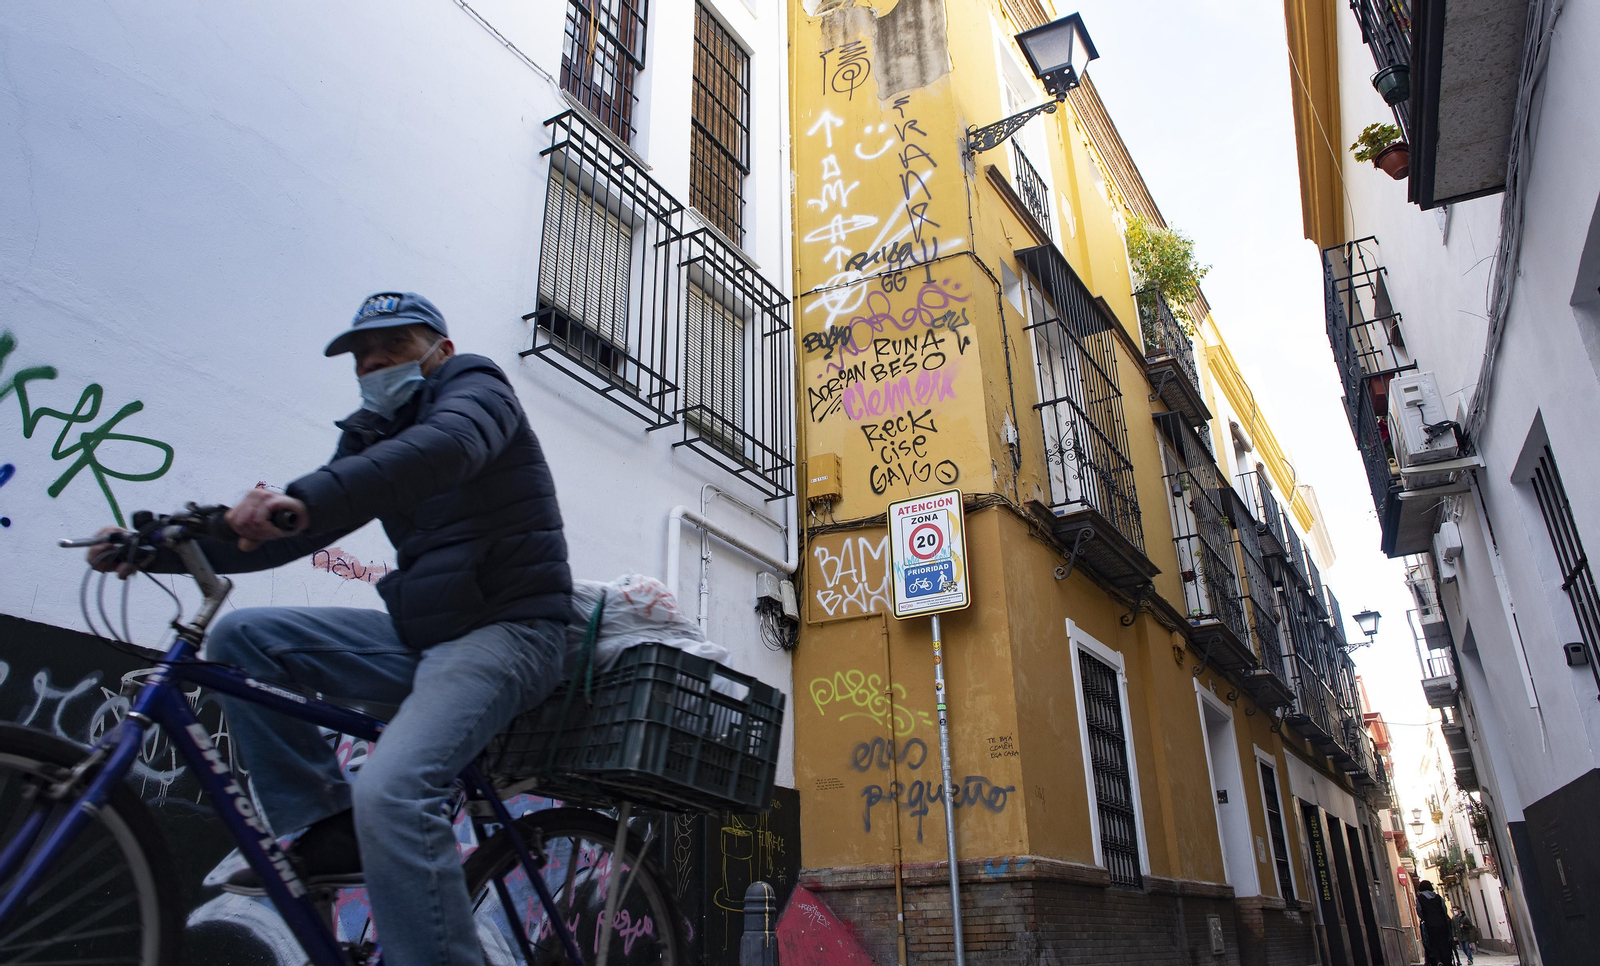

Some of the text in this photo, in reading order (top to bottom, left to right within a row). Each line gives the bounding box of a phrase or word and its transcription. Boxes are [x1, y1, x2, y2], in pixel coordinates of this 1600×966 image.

[873, 329, 945, 362] RUNA
[870, 352, 946, 383] BESO
[870, 460, 959, 495] GALGO
[898, 497, 953, 516] ATENCIÓN
[911, 513, 939, 525] ZONA
[917, 533, 936, 549] 20
[907, 563, 949, 576] PRIORIDAD
